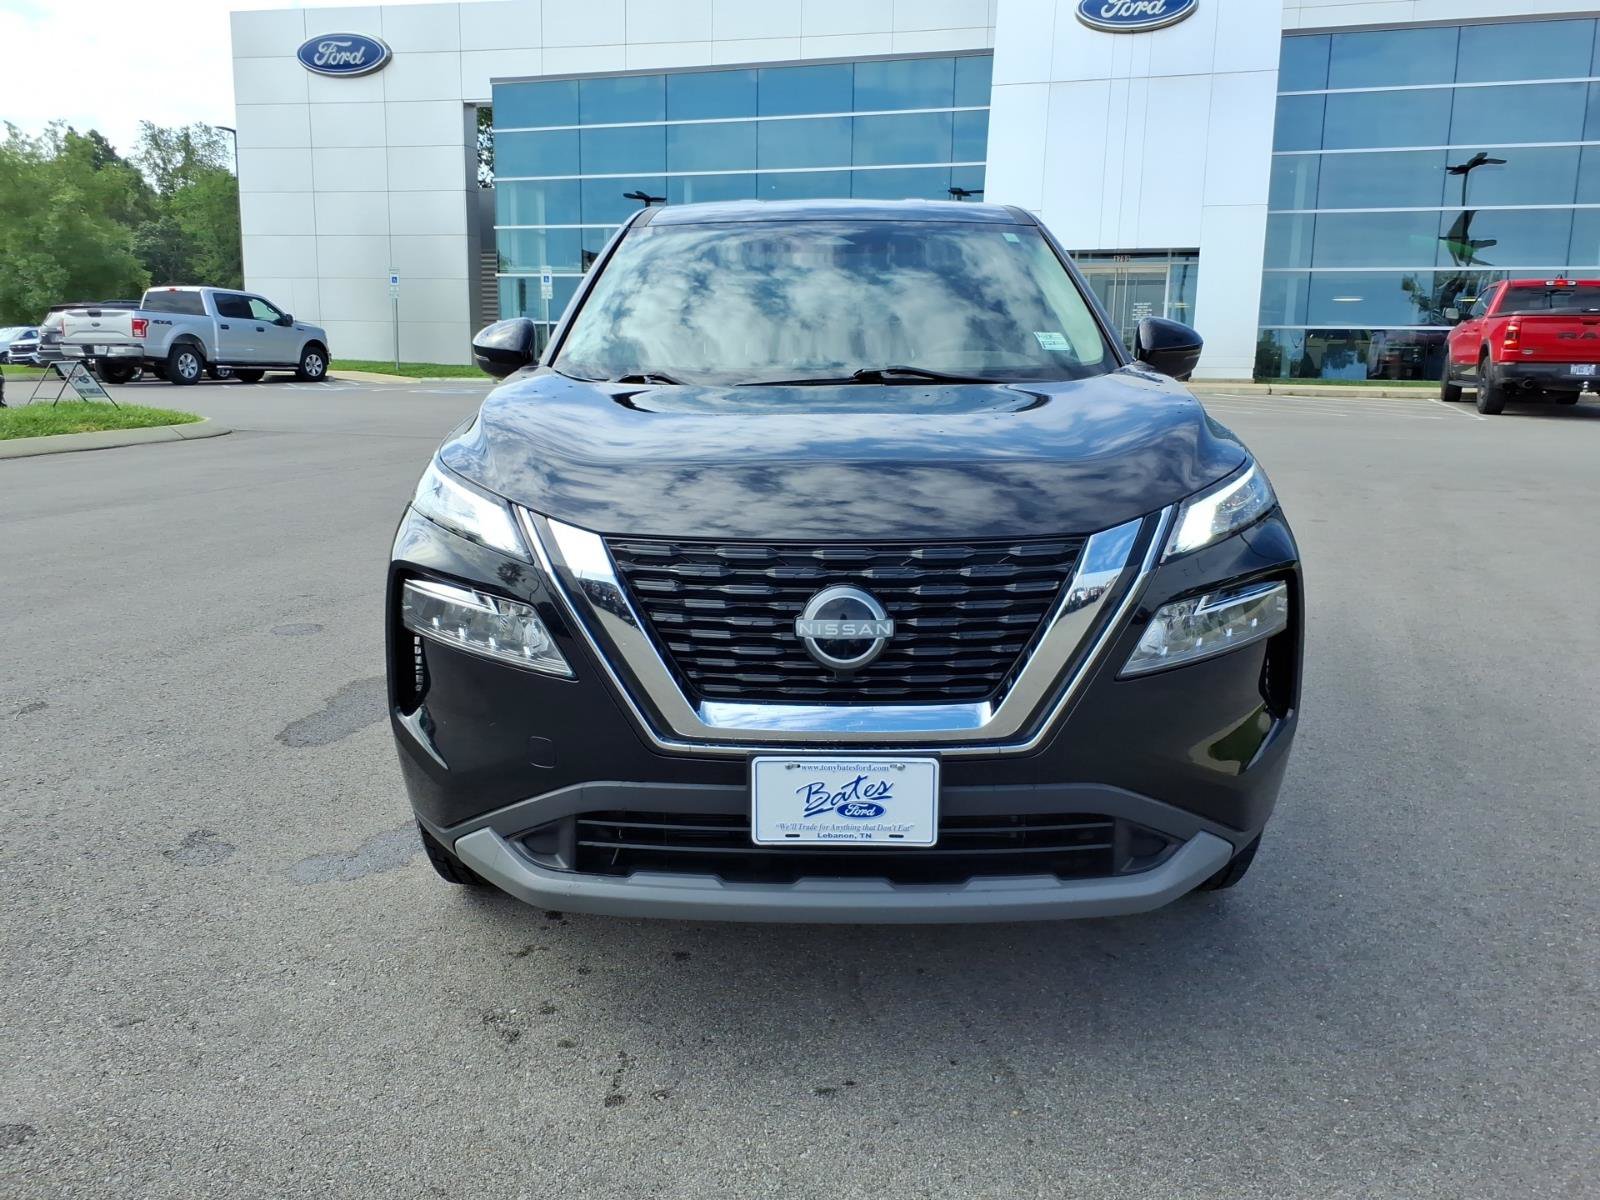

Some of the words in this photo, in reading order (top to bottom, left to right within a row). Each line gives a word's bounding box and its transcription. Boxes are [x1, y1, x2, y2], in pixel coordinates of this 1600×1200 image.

[1100, 0, 1166, 18] Ford
[313, 40, 366, 66] Ford
[799, 622, 891, 636] NISSAN
[801, 763, 890, 773] www.tonybatesford.com
[796, 775, 894, 812] Bates
[844, 802, 876, 816] Ford
[799, 823, 818, 831] Trade
[818, 823, 830, 832] for
[831, 823, 861, 832] Anything
[862, 823, 876, 831] that
[877, 824, 896, 832] Don't
